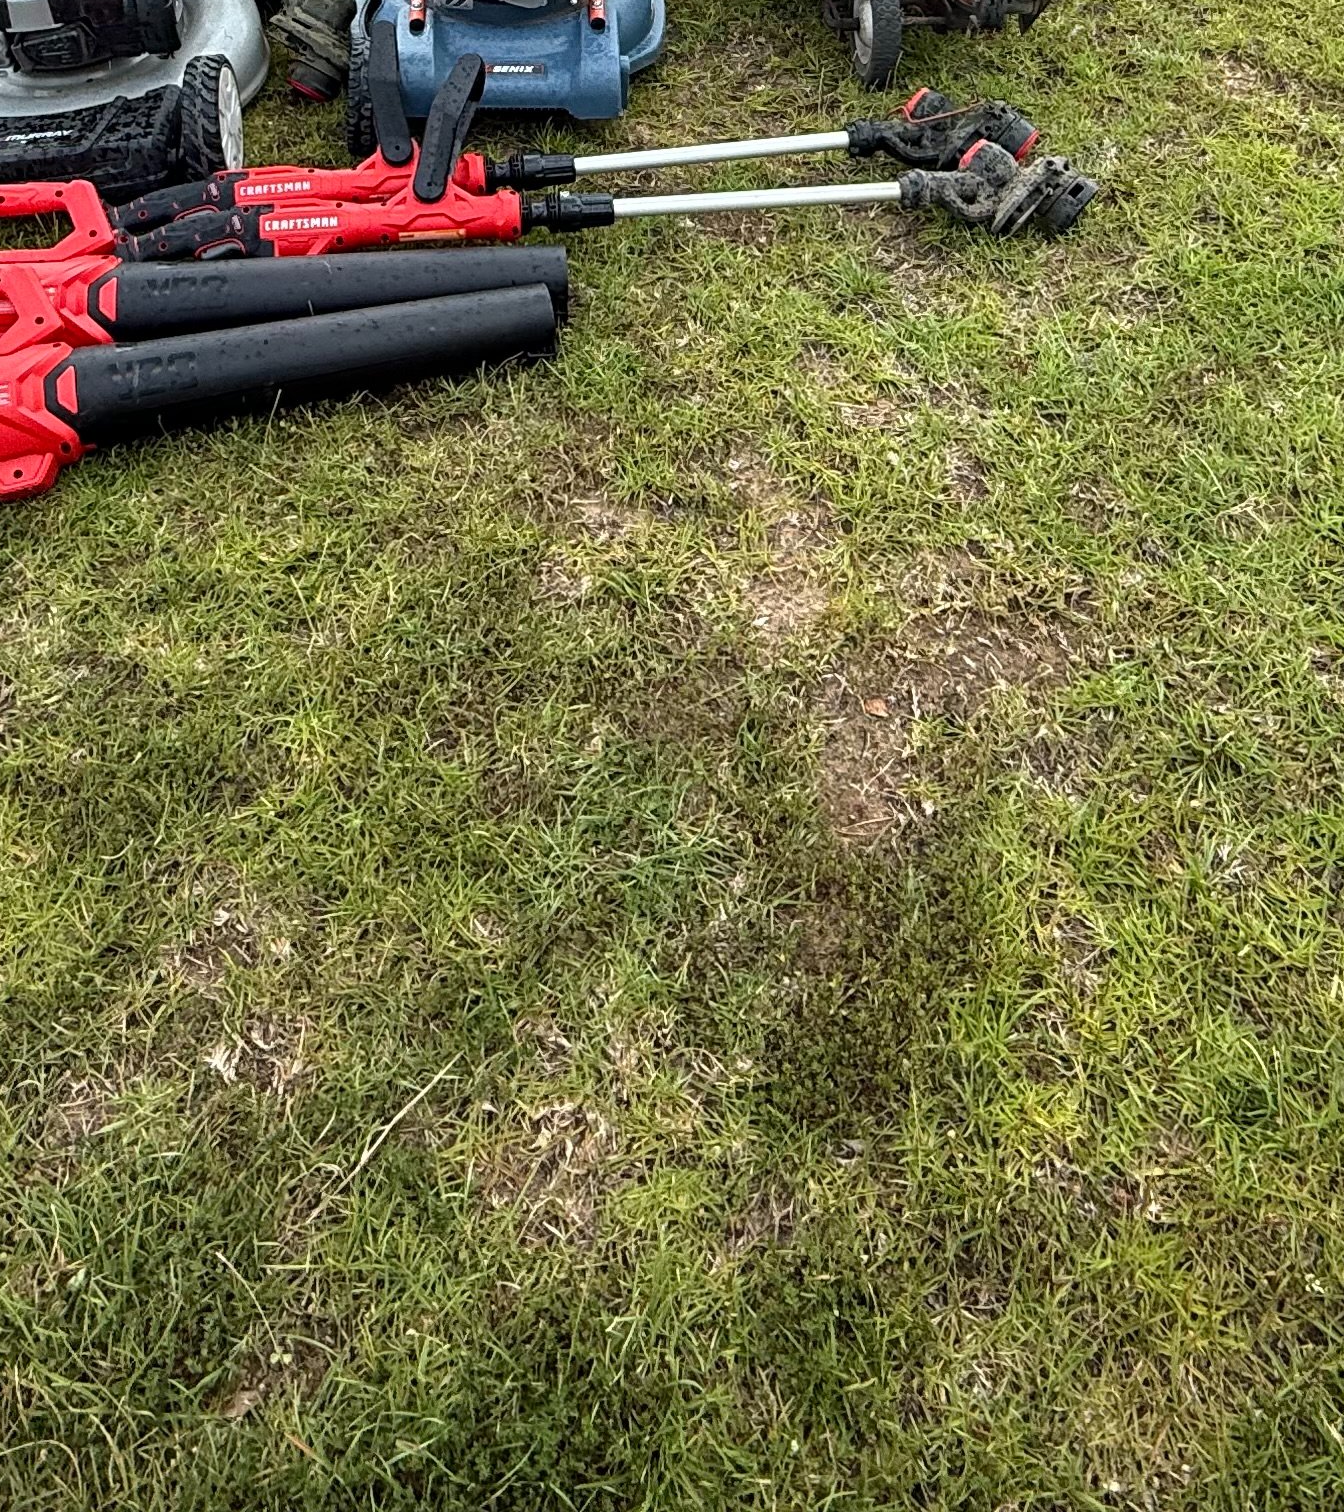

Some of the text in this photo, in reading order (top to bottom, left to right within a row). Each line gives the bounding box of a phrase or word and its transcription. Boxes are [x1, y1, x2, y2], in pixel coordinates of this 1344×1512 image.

[492, 65, 535, 73] SENIX
[4, 129, 74, 142] MURRAY
[239, 180, 311, 196] CRAFTSMAN
[264, 216, 339, 231] CRAFTSMAN
